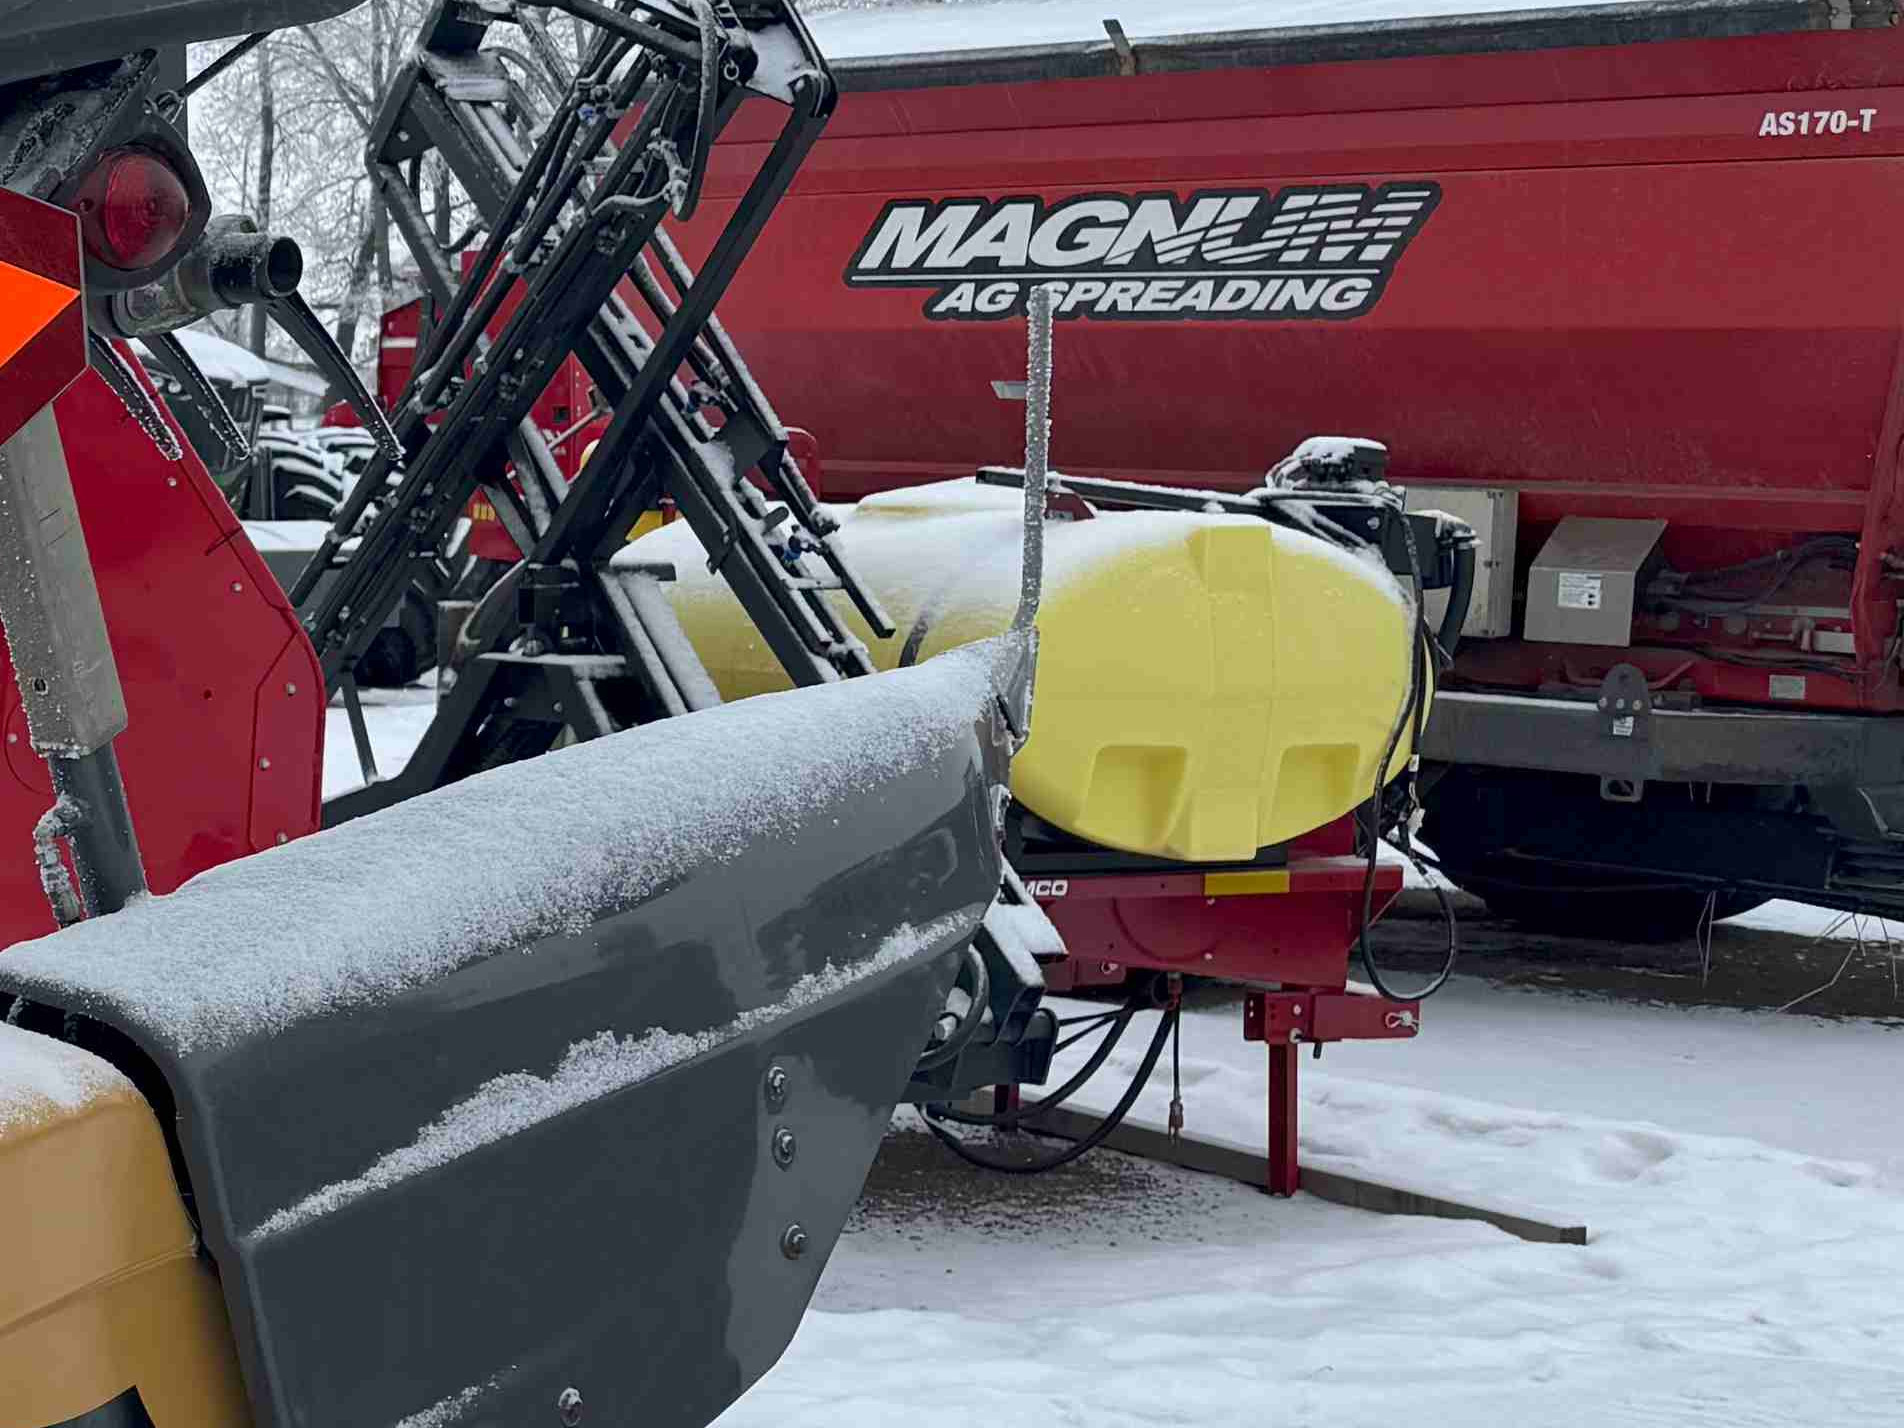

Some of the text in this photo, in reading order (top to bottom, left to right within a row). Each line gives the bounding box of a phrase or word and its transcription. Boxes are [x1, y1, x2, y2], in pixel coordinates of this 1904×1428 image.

[1759, 108, 1877, 137] AS170-T
[858, 190, 1431, 269] MAGNUM
[933, 278, 1373, 313] AG SPREADING
